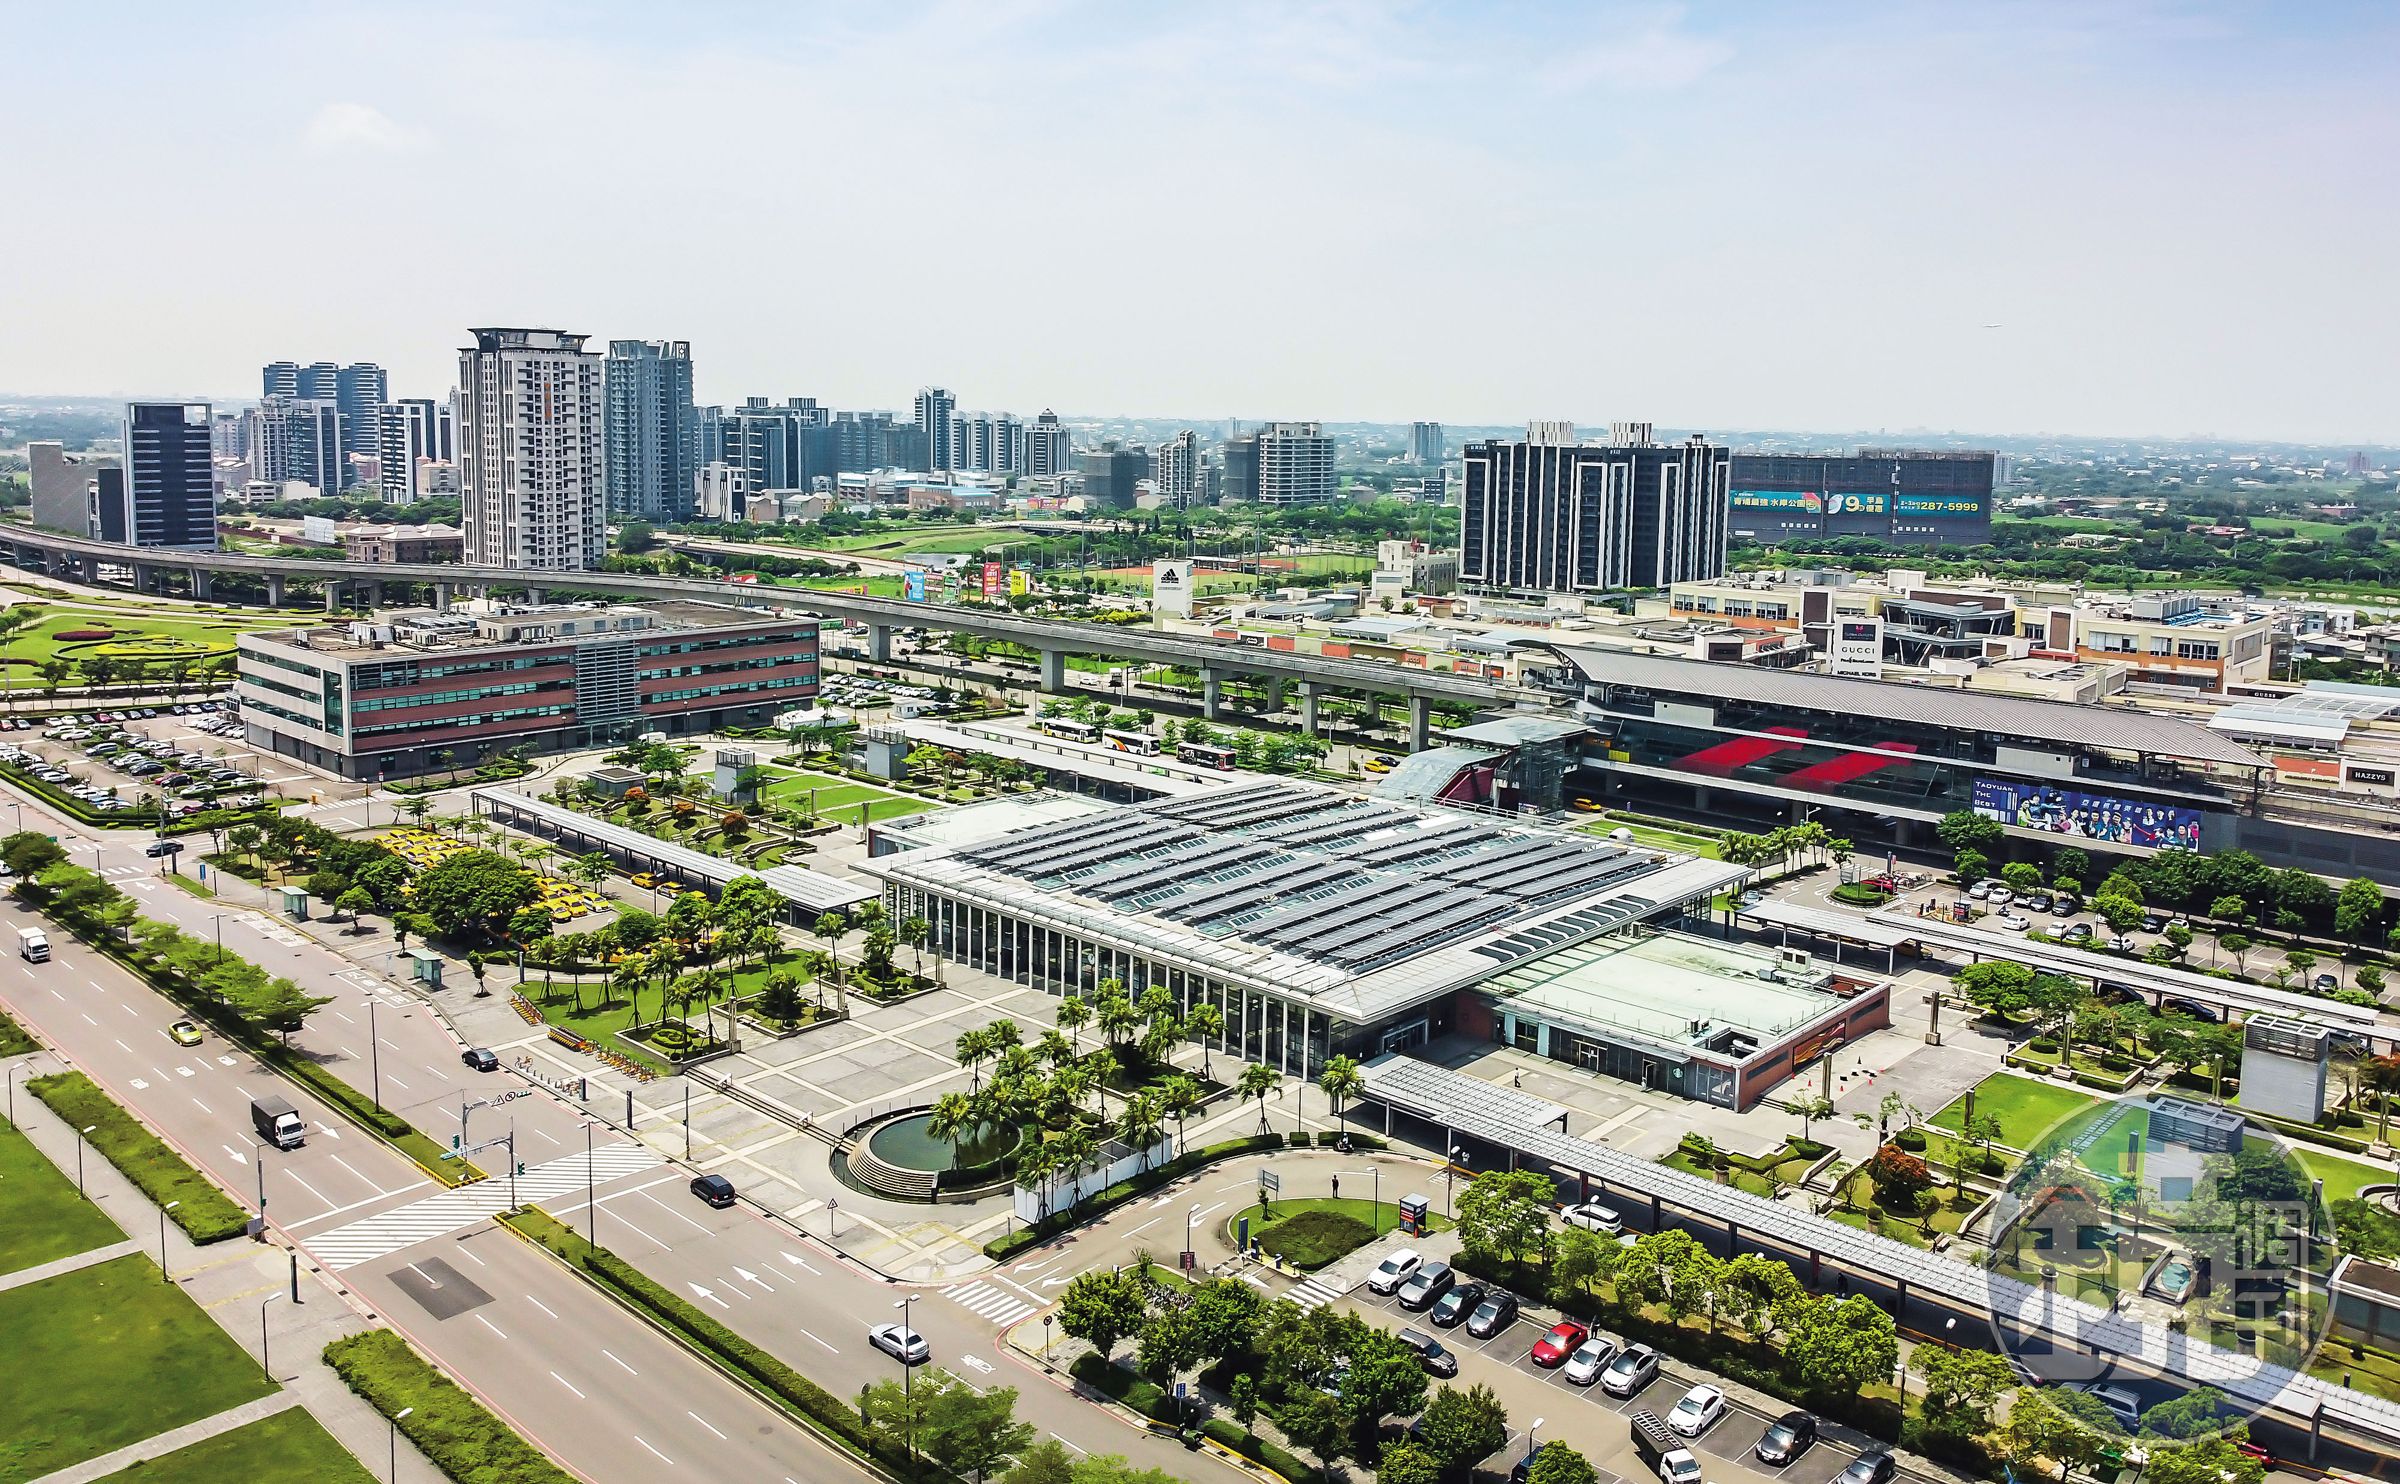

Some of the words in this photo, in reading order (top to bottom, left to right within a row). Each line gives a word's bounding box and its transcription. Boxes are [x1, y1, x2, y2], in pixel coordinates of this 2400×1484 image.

[1841, 646, 1875, 654] GUCCI
[2354, 770, 2386, 782] HAZZYS
[1975, 781, 2014, 792] TAOYUAN
[1975, 790, 1991, 798] THE
[1974, 799, 1996, 808] BEST
